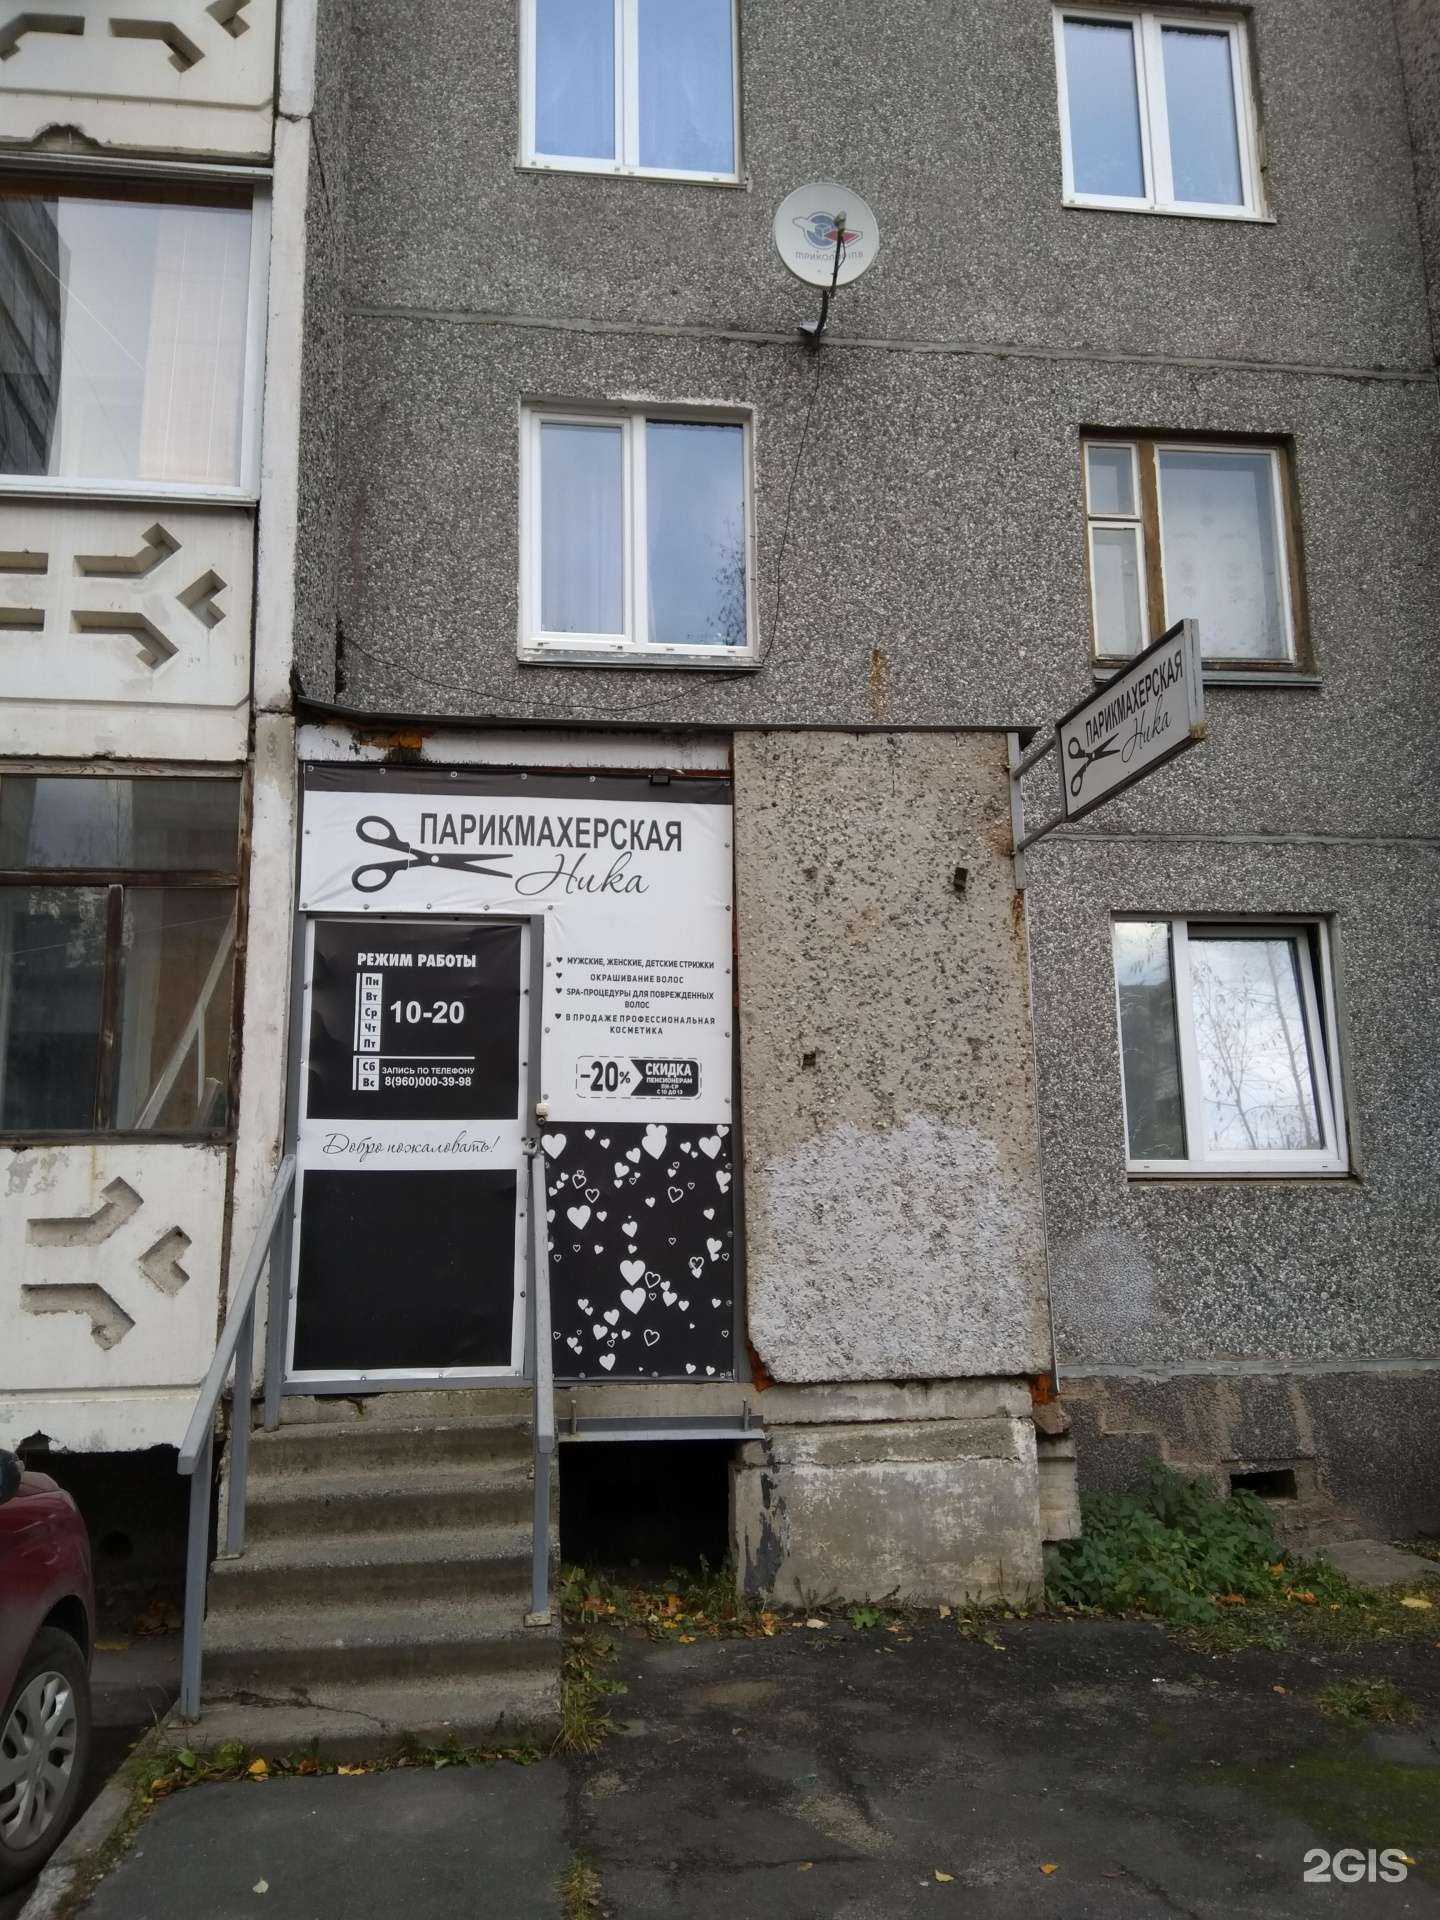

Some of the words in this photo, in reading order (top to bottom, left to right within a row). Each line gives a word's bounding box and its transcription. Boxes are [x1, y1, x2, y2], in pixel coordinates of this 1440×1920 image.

[1085, 648, 1183, 747] ПАРИКМАХЕРСКАЯ
[1121, 694, 1172, 763] Ника
[420, 812, 682, 852] ПАРИКМАХЕРСКАЯ
[515, 851, 649, 896] Ника
[357, 952, 413, 967] РЕЖИМ
[417, 953, 477, 968] РАБОТЫ
[567, 957, 605, 967] МУЖСКИЕ,
[607, 958, 644, 968] ЖЕНСКИЕ,
[645, 959, 678, 969] ДЕТСКИЕ
[679, 960, 714, 969] СТРИЖКИ
[365, 976, 379, 987] Пн
[590, 974, 654, 983] ОКРАШИВАНИЕ
[365, 991, 378, 1002] Вт
[567, 988, 631, 998] SPA-ПРОЦЕДУРЫ
[632, 990, 648, 998] ДЛЯ
[650, 990, 714, 1000] ПОВРЕЖДЕННЫХ
[365, 1007, 378, 1019] Ср
[390, 1000, 465, 1024] 10-20
[573, 1014, 617, 1022] ПРОДАЖЕ
[620, 1015, 715, 1024] ПРОФЕССИОНАЛЬНАЯ
[364, 1023, 377, 1034] Чт
[363, 1039, 376, 1049] Пт
[362, 1061, 376, 1072] Сб
[382, 1067, 415, 1075] ЗАПИСЬ
[417, 1067, 429, 1075] ПО
[430, 1067, 475, 1076] ТЕЛЕФОНУ
[645, 1062, 692, 1077] СКИДКА
[362, 1077, 375, 1087] Вс
[384, 1076, 472, 1089] 8(960)000-39-98
[322, 1132, 384, 1163] Добро
[386, 1130, 501, 1154] пожаловать!
